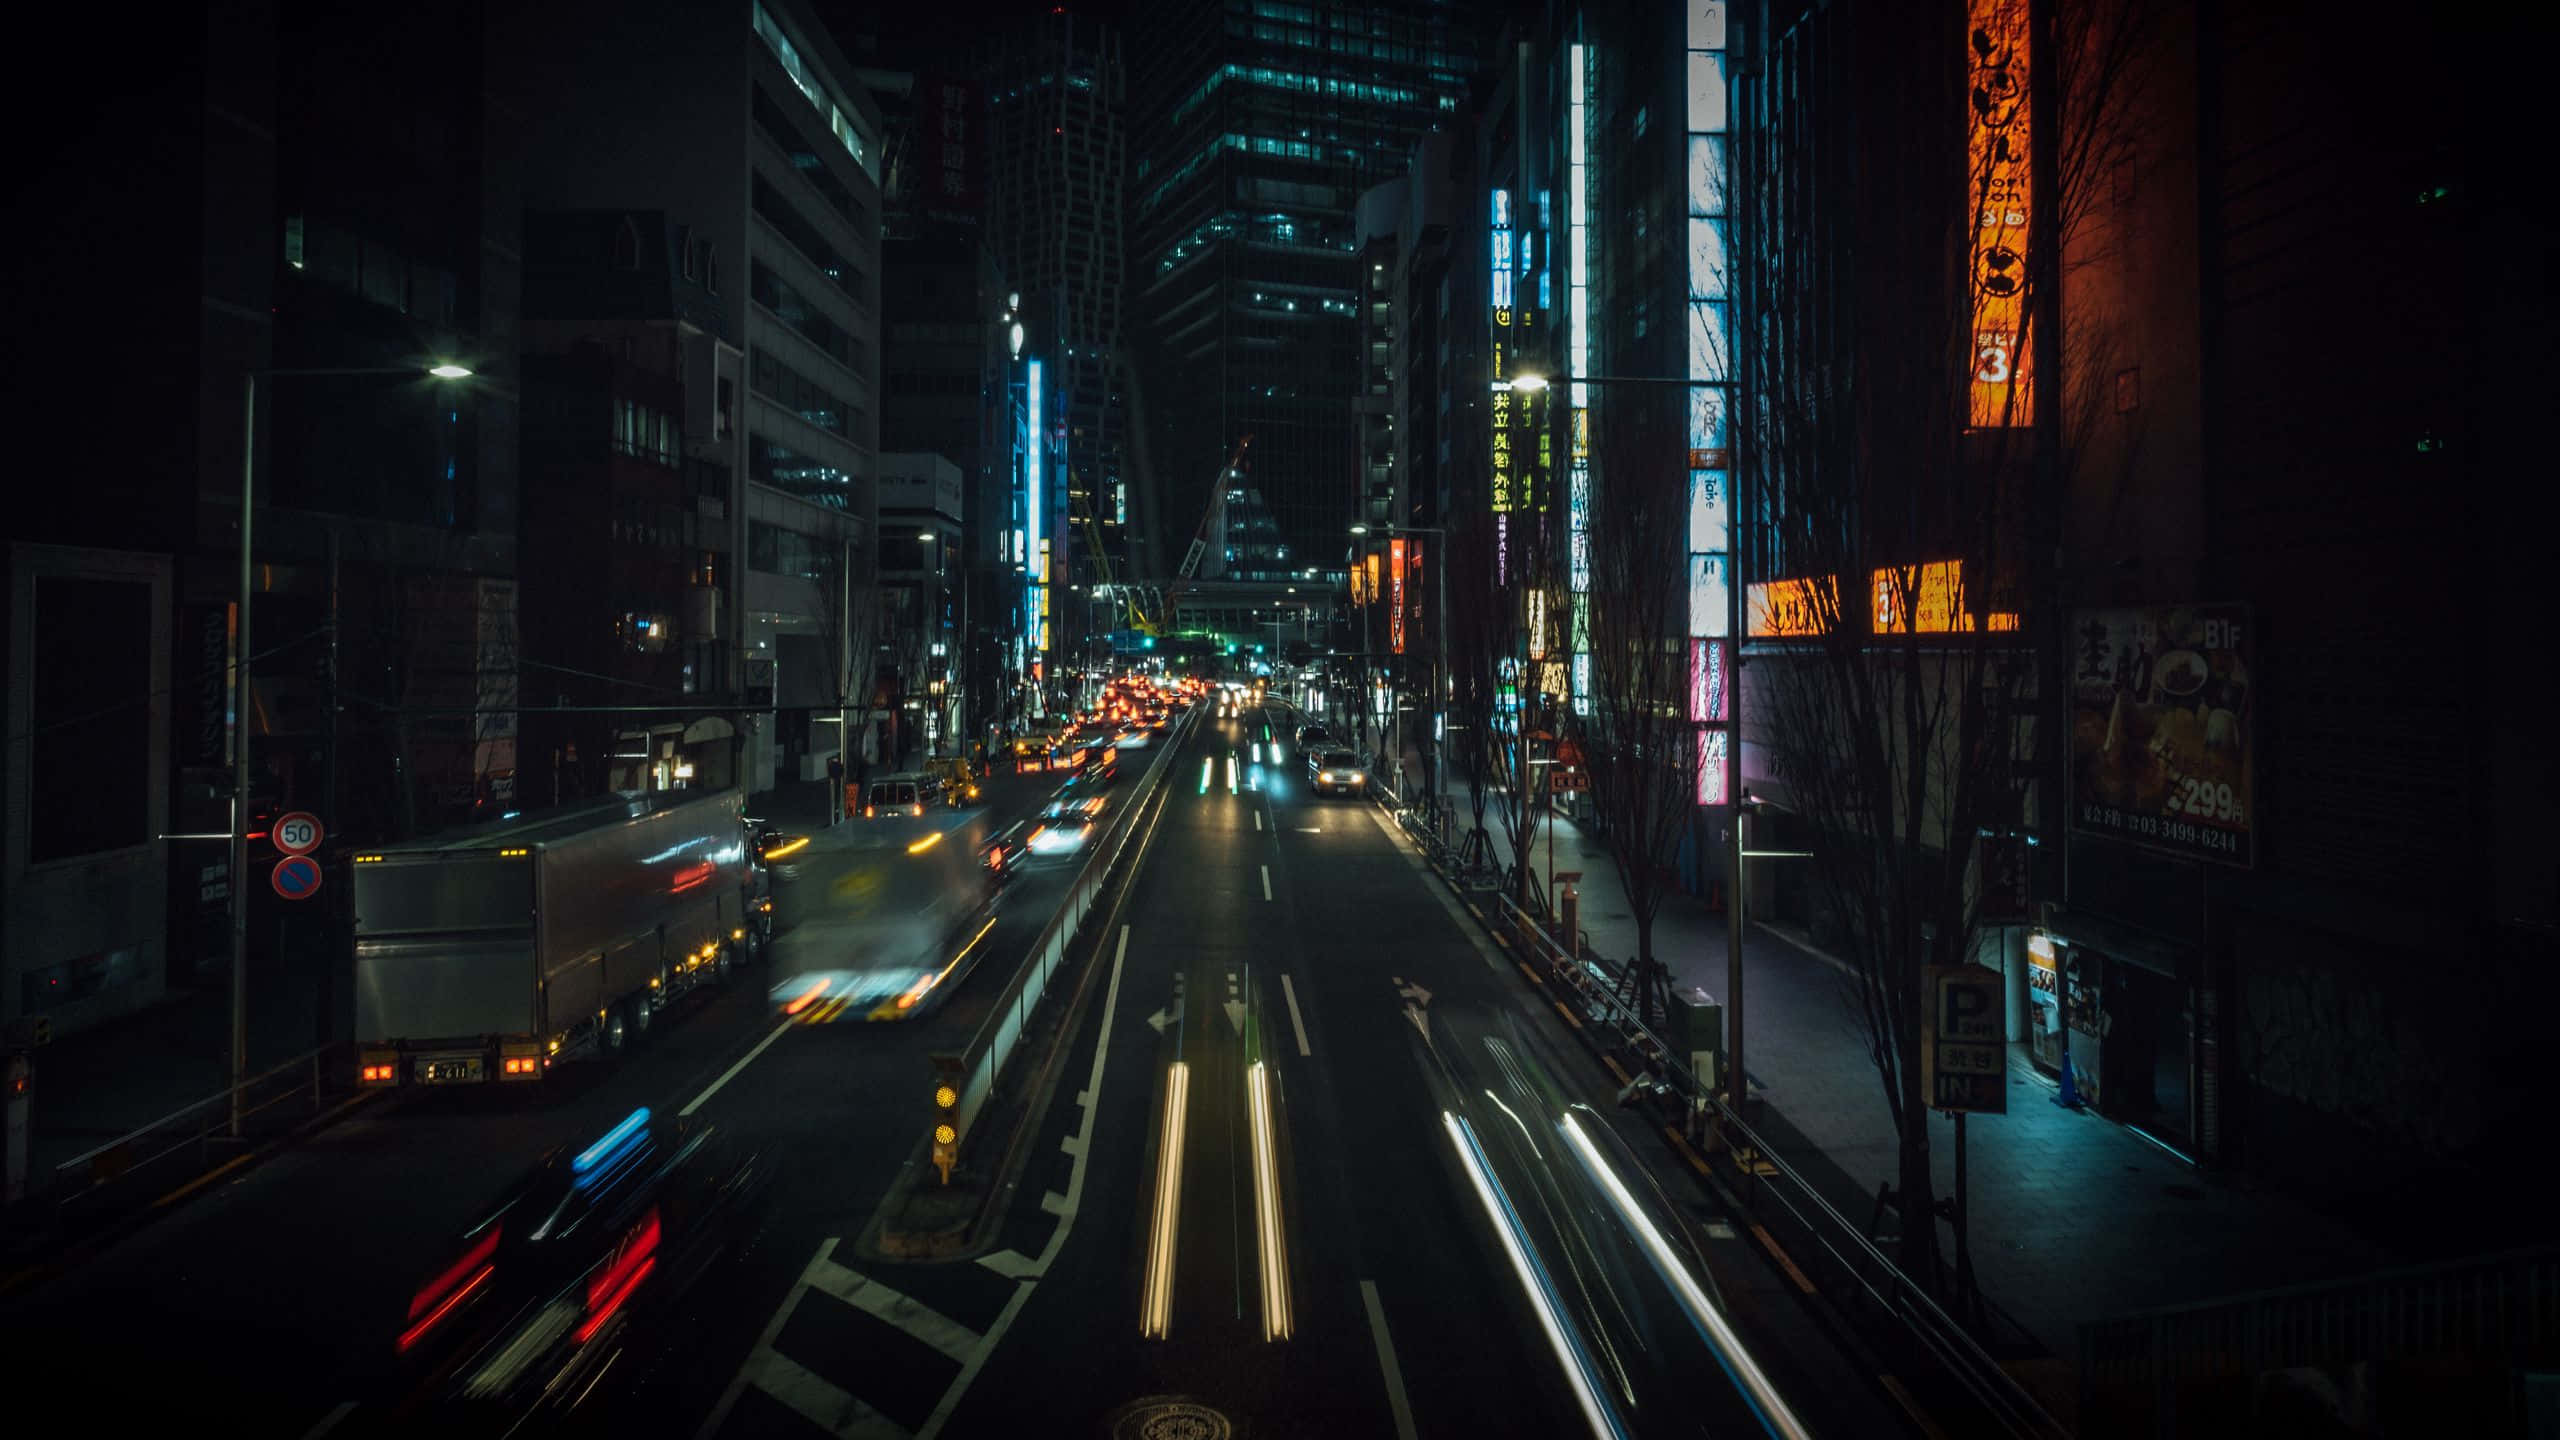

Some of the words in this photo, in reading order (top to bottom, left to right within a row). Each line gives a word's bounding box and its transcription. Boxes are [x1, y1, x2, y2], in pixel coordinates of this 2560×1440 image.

[2204, 619, 2240, 649] B1F
[285, 824, 312, 843] 50
[1947, 987, 1989, 1034] P
[1938, 1076, 1971, 1098] IN
